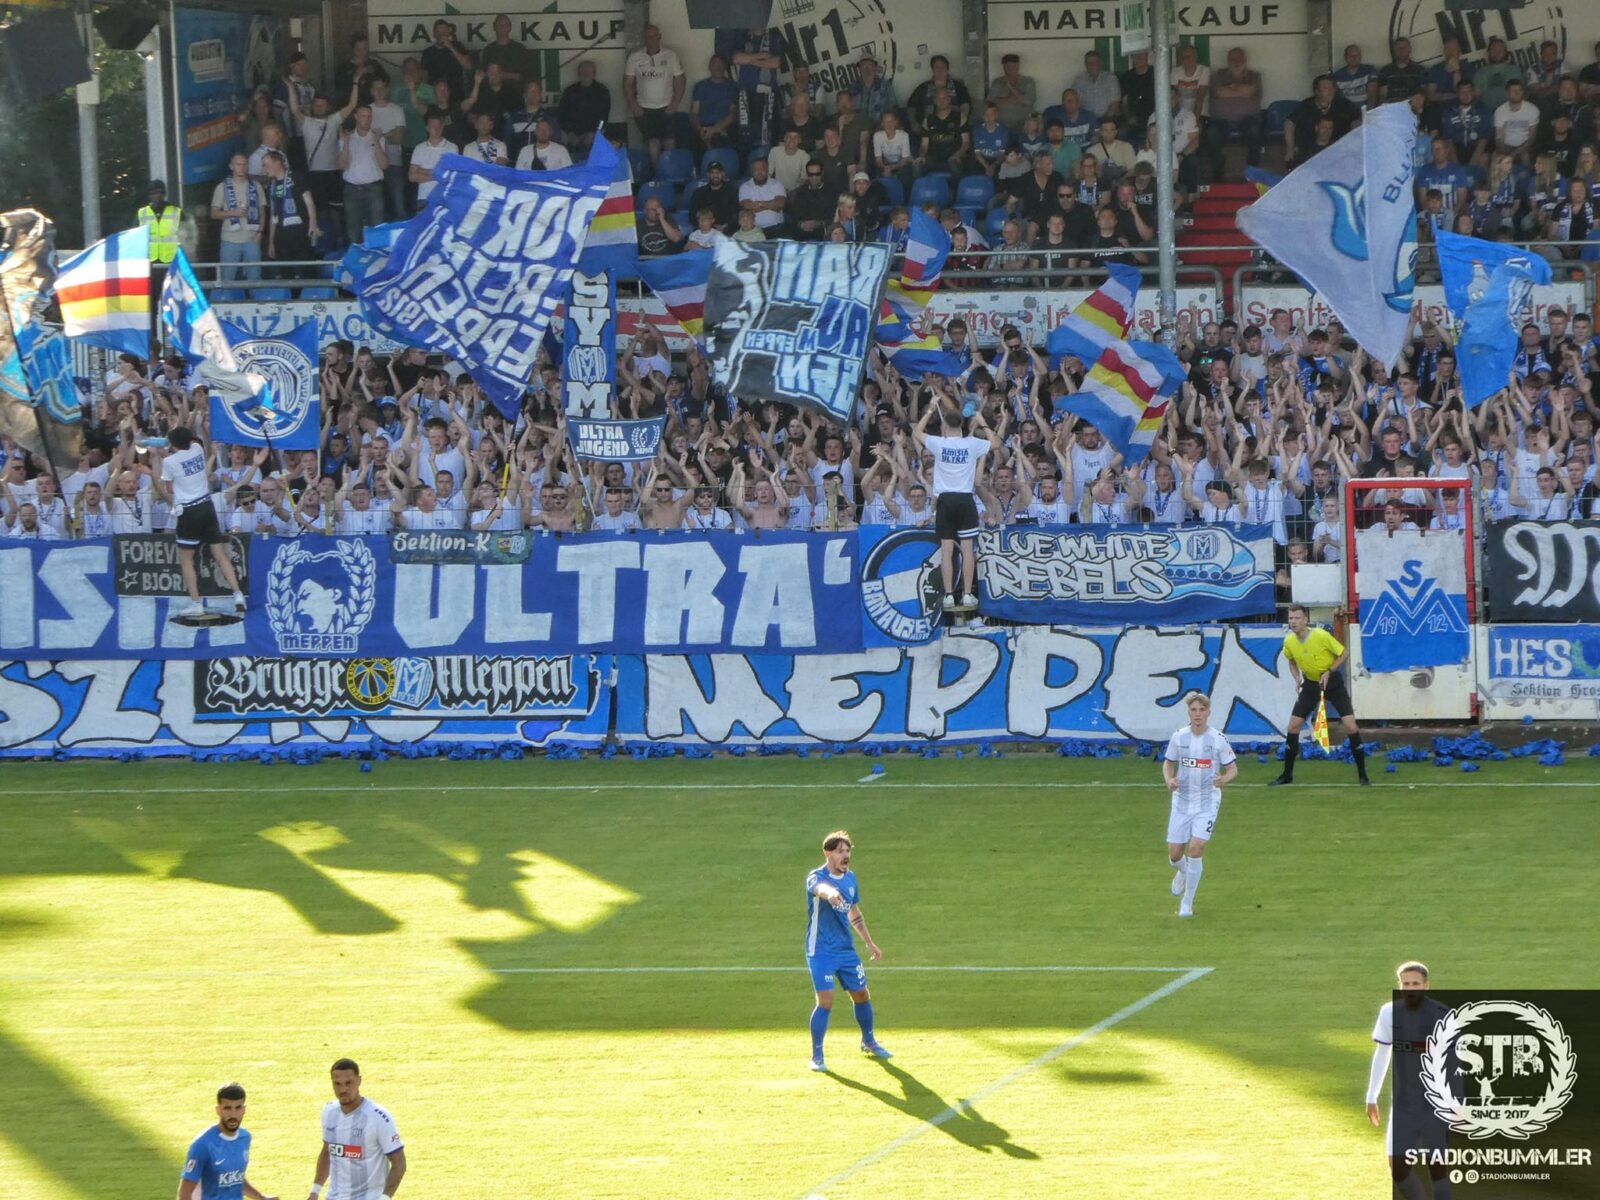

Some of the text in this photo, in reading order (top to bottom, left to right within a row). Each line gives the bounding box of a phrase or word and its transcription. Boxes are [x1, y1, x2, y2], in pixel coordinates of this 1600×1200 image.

[579, 424, 624, 440] ULTRA
[576, 439, 630, 457] JUGEND
[142, 568, 186, 593] BJÖR
[978, 553, 1174, 601] REBELS
[283, 634, 355, 650] MEPPEN
[1510, 682, 1562, 697] Sektion
